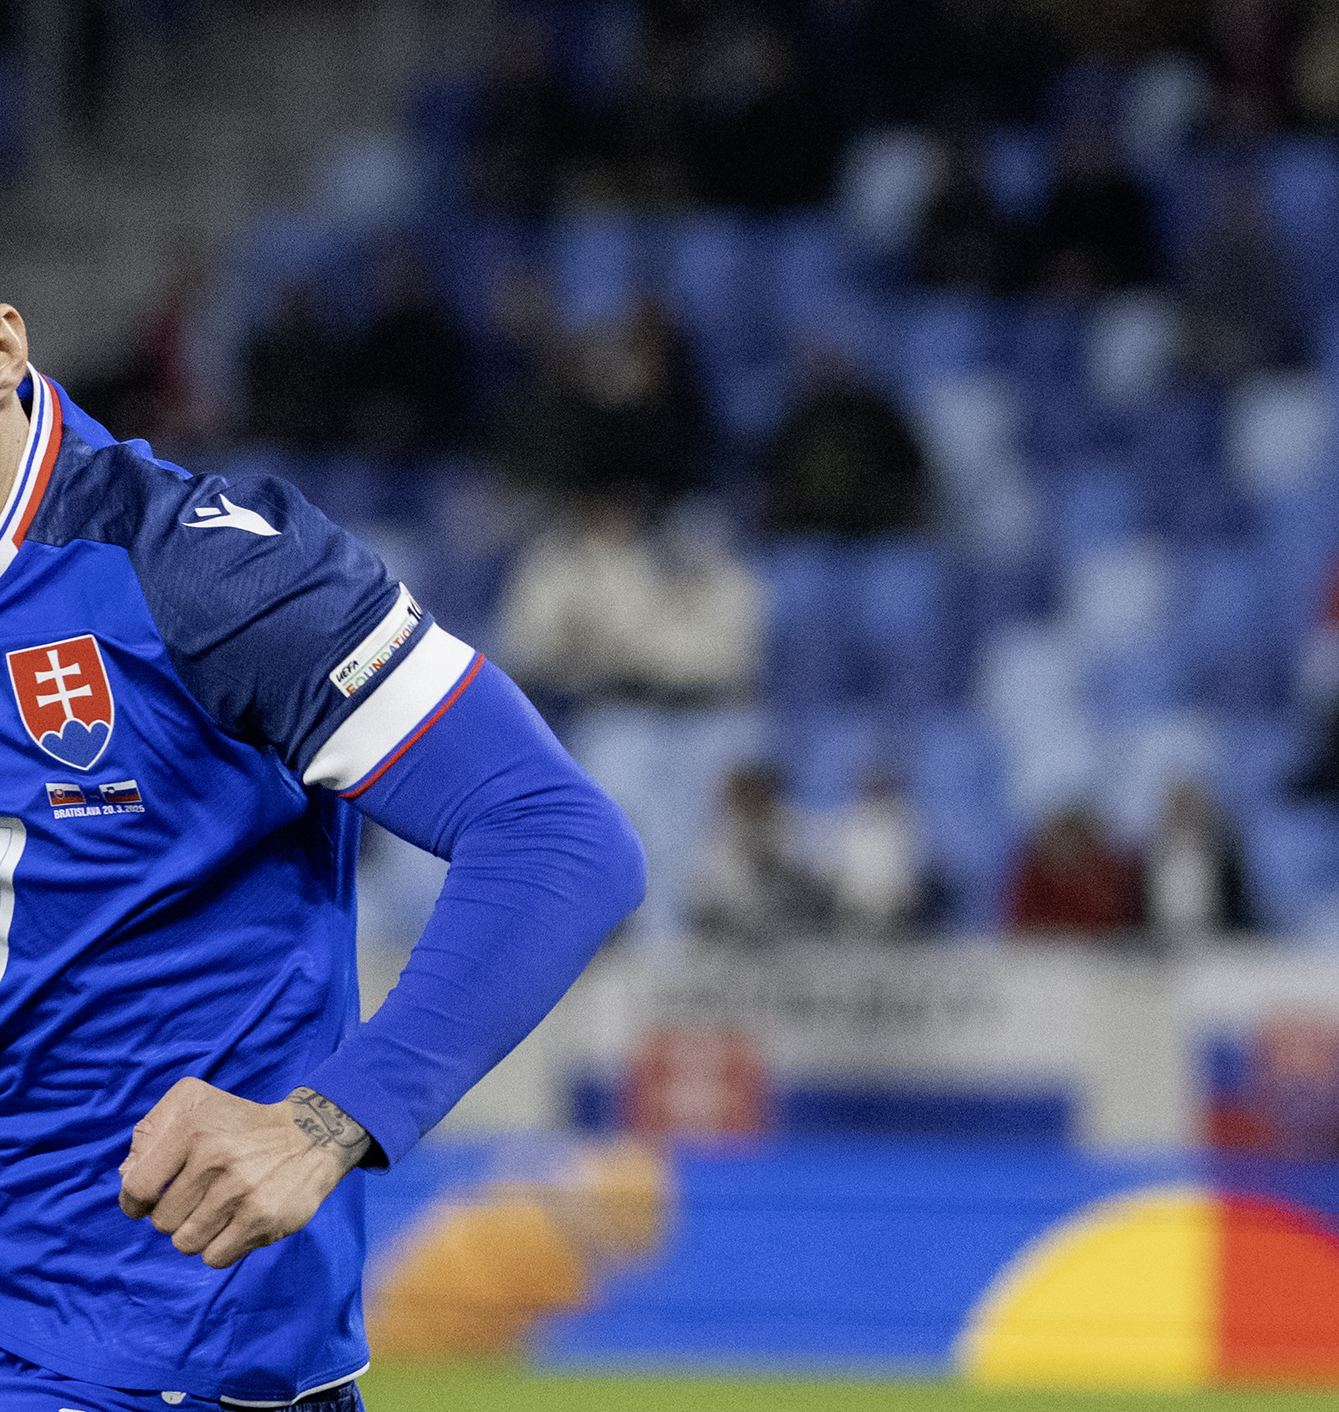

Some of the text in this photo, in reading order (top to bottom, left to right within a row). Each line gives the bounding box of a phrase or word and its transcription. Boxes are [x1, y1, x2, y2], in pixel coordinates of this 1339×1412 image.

[335, 659, 360, 683] UEFA
[53, 804, 145, 819] BRATISLAVA 20.3.2025
